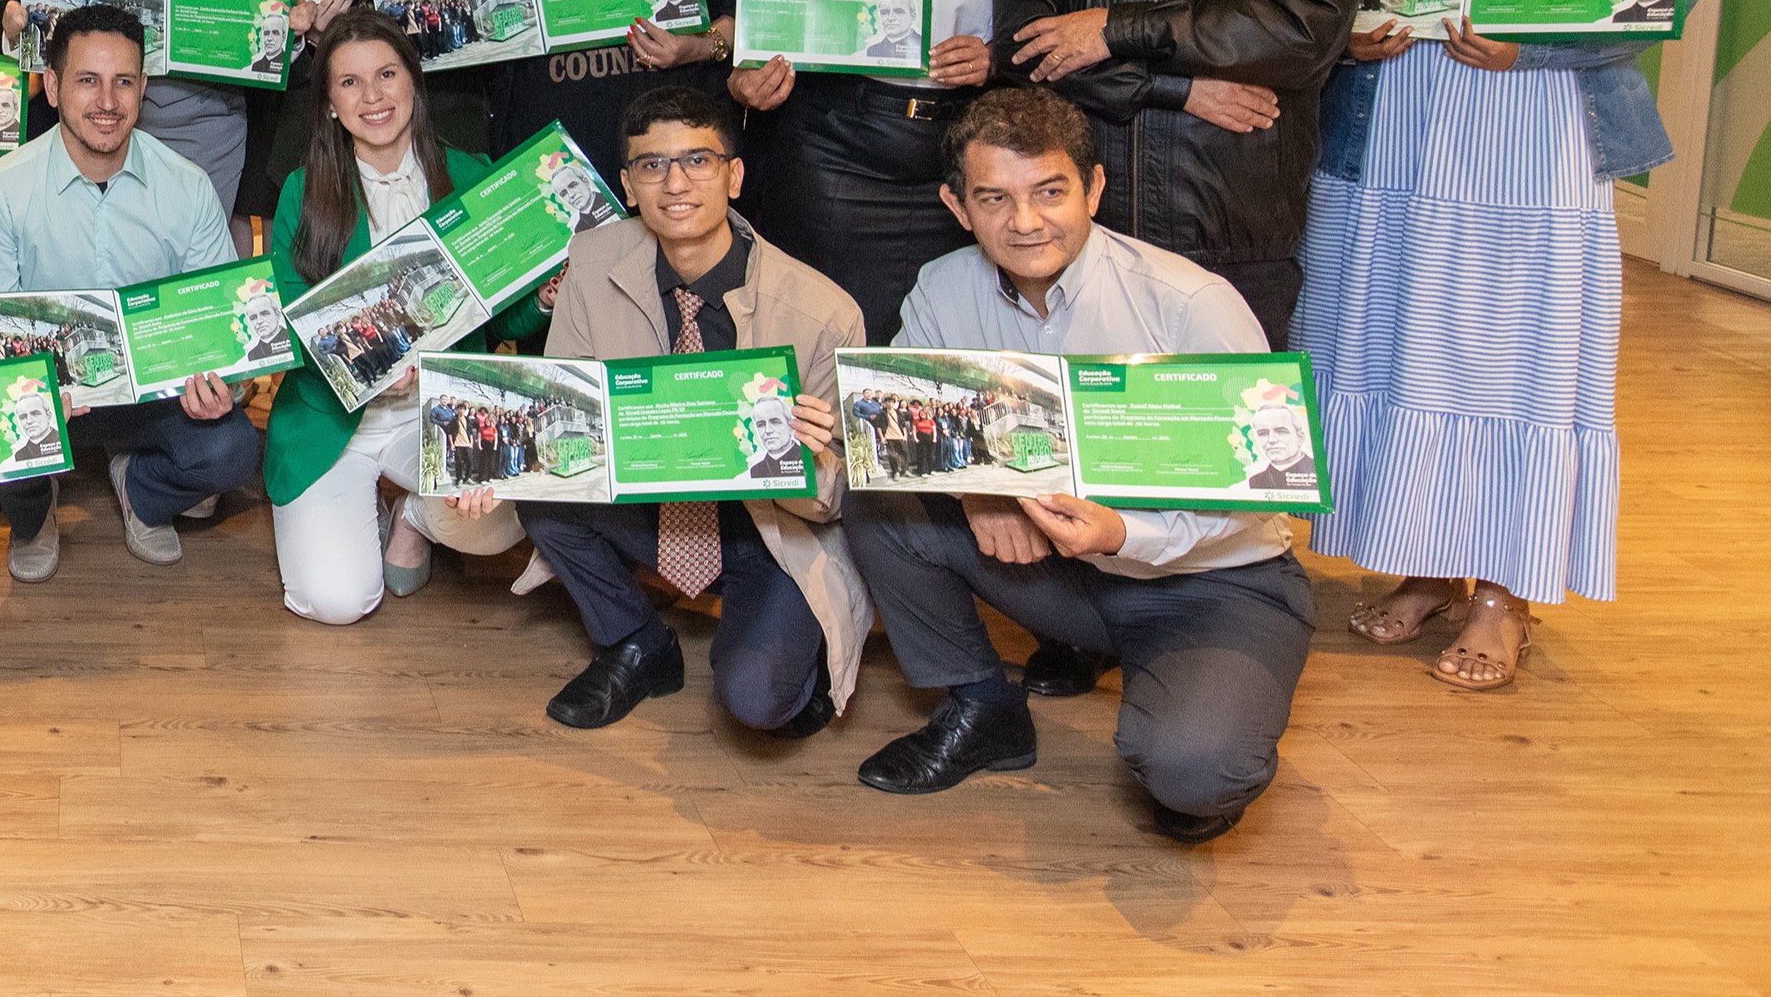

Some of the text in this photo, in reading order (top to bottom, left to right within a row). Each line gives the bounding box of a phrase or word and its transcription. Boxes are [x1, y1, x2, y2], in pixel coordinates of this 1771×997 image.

[549, 46, 657, 82] COUN
[480, 170, 517, 198] CERTIFICADO
[177, 280, 220, 295] CERTIFICADO
[674, 370, 724, 381] CERTIFICADO
[1154, 373, 1217, 382] CERTIFICADO
[615, 378, 648, 386] Corporativa
[771, 479, 799, 487] Sicredi
[1277, 492, 1310, 500] Sicredi
